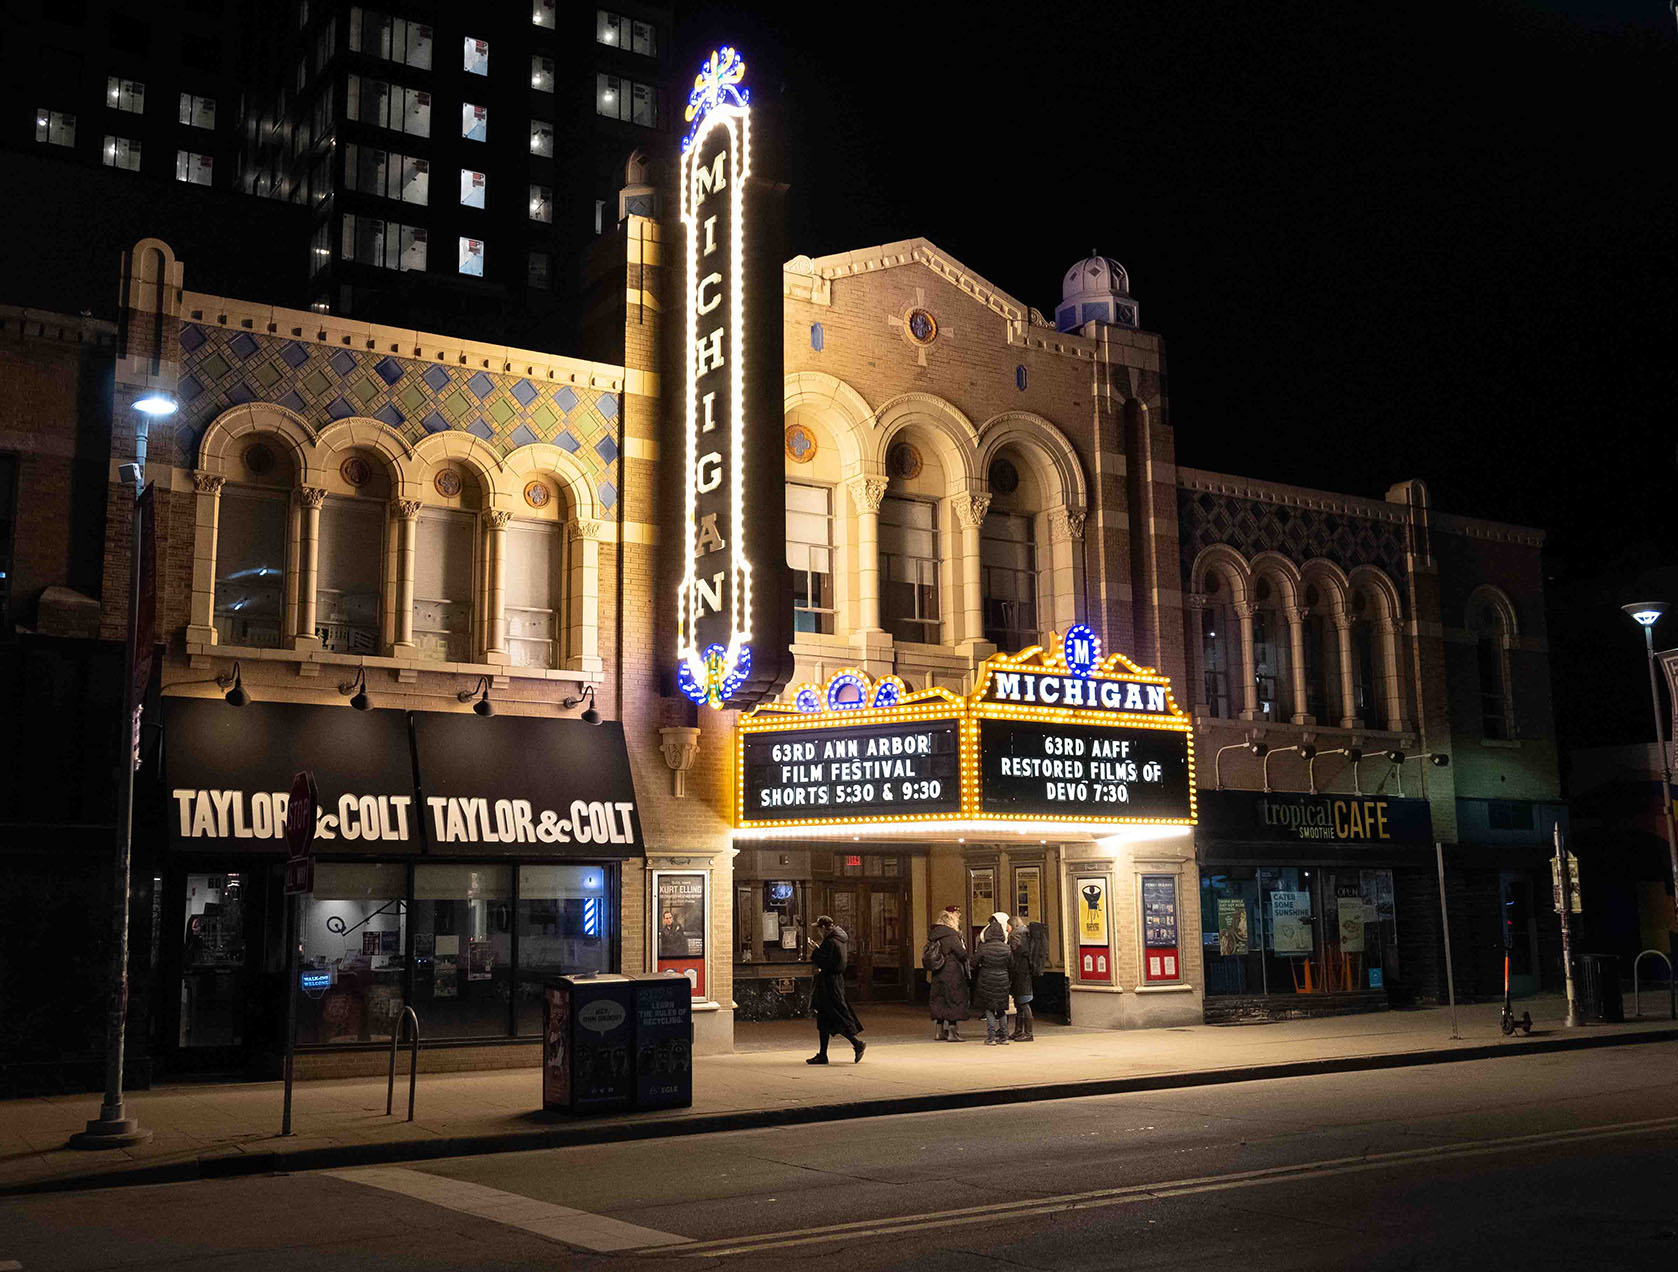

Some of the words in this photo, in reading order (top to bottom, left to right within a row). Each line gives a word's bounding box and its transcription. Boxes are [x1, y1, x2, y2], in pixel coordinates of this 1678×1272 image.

[695, 150, 727, 620] MICHIGAN
[1074, 639, 1090, 665] M
[995, 672, 1166, 711] MICHIGAN
[772, 742, 815, 762] 63RD
[823, 740, 858, 759] ANN
[866, 735, 930, 757] ARBOR
[1045, 736, 1084, 756] 63RD
[1091, 739, 1130, 758] AAFF
[782, 764, 823, 784] FILM
[831, 759, 915, 781] FESTIVAL
[1001, 757, 1083, 778] RESTORED
[1090, 761, 1137, 781] FILMS
[1143, 763, 1162, 782] OF
[760, 785, 829, 807] SHORTS
[835, 784, 874, 803] 5:30
[882, 783, 893, 801] &
[902, 780, 941, 800] 9:30
[1046, 782, 1087, 802] DEVO
[1093, 784, 1128, 803] 7:30
[287, 798, 309, 831] STOP
[1263, 798, 1334, 831] tropical
[1334, 800, 1391, 840] CAFE
[1299, 826, 1335, 839] SMOOTHIE
[659, 885, 678, 894] KURT
[679, 885, 702, 894] ELLING
[1273, 893, 1296, 901] CATER
